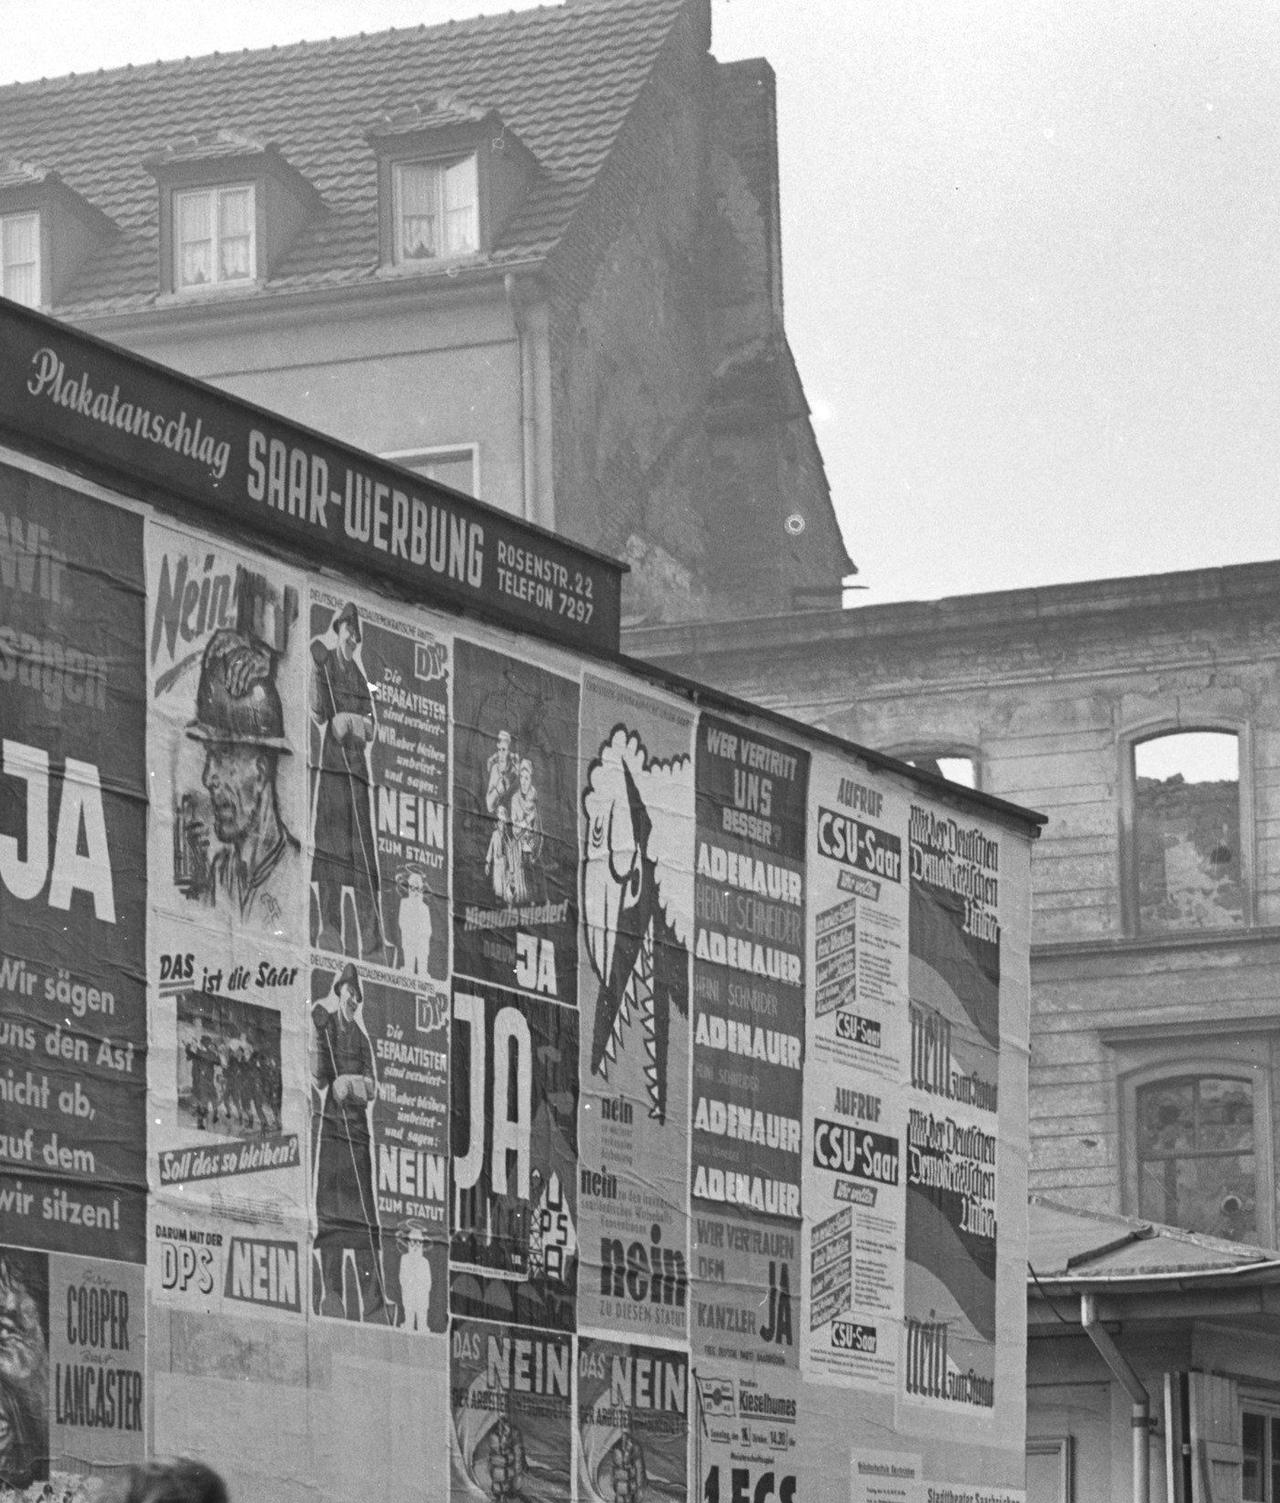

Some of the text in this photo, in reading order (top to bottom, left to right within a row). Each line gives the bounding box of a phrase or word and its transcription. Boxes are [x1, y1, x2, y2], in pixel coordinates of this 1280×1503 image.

[27, 347, 231, 479] Plakatanschlag
[247, 429, 484, 589] SAAR-WERBUNG
[497, 567, 593, 625] TELEFON 7297
[575, 574, 593, 599] 22
[373, 681, 446, 721] SEPARATISTEN
[378, 724, 396, 744] WIR
[708, 726, 798, 781] WER VERTRITT
[378, 784, 445, 851] NEIN
[734, 768, 773, 817] UNS
[837, 777, 883, 819] AUFRUF
[378, 837, 444, 870] ZUM STATUT
[819, 811, 901, 881] CSU-Saar
[697, 842, 802, 907] ADENAUER
[736, 895, 801, 949] SCHNEIDER
[160, 953, 298, 993] DAS ist die Saar
[516, 932, 558, 996] JA
[696, 928, 802, 986] ADENAUER
[44, 968, 115, 1017] sägen
[45, 1024, 89, 1063] den
[376, 1038, 447, 1073] SEPARATISTEN
[386, 1023, 404, 1040] Die
[695, 1012, 801, 1071] ADENAUER
[836, 1012, 881, 1047] CSU-Saar
[58, 1082, 96, 1121] ab,
[378, 1083, 397, 1103] WIR
[453, 991, 532, 1202] JA
[834, 1086, 881, 1123] AUFRUF
[694, 1096, 801, 1155] ADENAUER
[42, 1133, 96, 1173] dem
[162, 1137, 299, 1181] Soll das so bleiben?
[379, 1143, 445, 1201] NEIN
[816, 1123, 898, 1183] CSU-Saar
[581, 1165, 618, 1199] nein
[693, 1165, 800, 1218] ADENAUER
[42, 1188, 120, 1231] sitzen!
[155, 1224, 223, 1247] DARUM MIT DER
[379, 1196, 445, 1222] ZUM STATUT
[161, 1240, 298, 1305] DPS NEIN
[601, 1223, 686, 1307] nein
[66, 1283, 130, 1351] COOPER
[698, 1261, 793, 1346] KANZLER JA
[832, 1322, 876, 1351] CSU-Saar
[453, 1330, 481, 1361] DAS
[486, 1335, 569, 1398] NEIN
[579, 1351, 606, 1381] DAS
[610, 1354, 686, 1415] NEIN
[55, 1362, 142, 1431] LANCASTER
